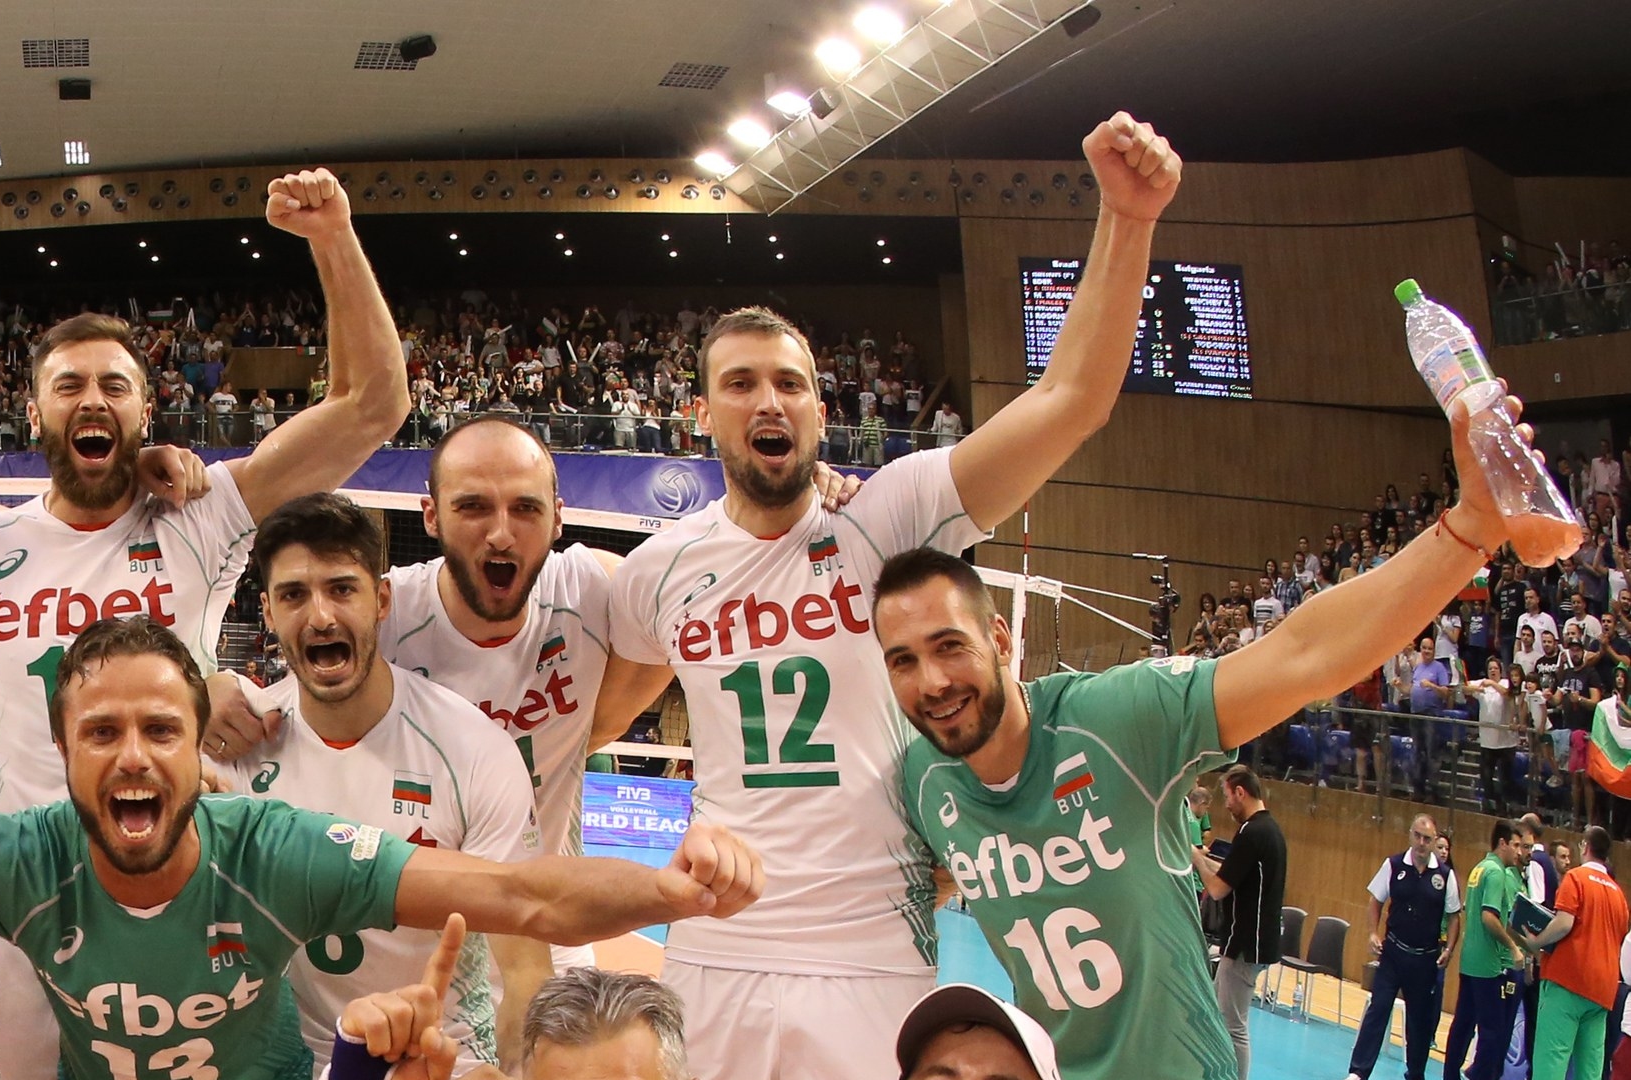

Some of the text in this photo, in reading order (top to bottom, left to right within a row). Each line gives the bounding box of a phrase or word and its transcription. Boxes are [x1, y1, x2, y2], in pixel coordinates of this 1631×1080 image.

[1174, 264, 1215, 274] Bulgaria
[129, 560, 163, 573] BUL
[812, 551, 844, 577] BUL
[678, 574, 870, 662] efbet
[26, 645, 66, 744] 1
[473, 669, 579, 730] bet
[720, 655, 835, 765] 12
[393, 801, 430, 819] BUL
[610, 806, 658, 815] VOLLEYBALL
[1056, 786, 1100, 816] BUL
[950, 809, 1126, 901] efbet
[211, 952, 252, 973] BUL
[1003, 907, 1123, 1012] 16
[53, 971, 264, 1036] fbet
